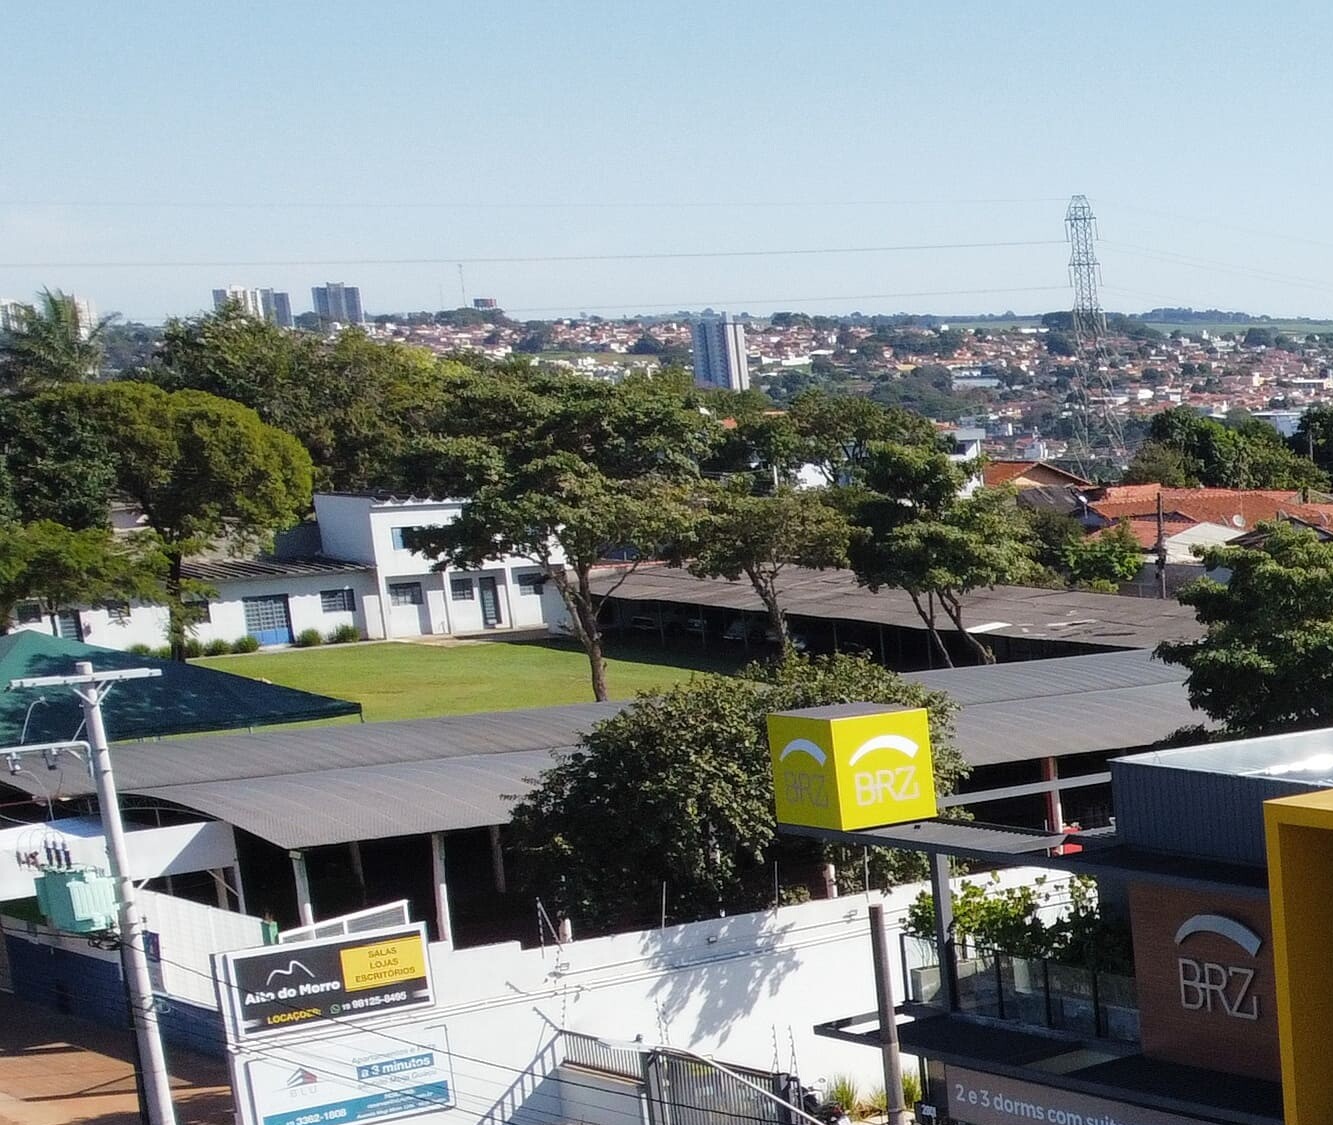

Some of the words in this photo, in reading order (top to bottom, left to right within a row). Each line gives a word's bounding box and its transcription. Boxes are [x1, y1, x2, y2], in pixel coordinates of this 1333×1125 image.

[784, 771, 829, 809] BRZ
[854, 765, 921, 807] BRZ
[368, 947, 397, 958] SALAS
[369, 957, 399, 969] LOJAS
[277, 982, 297, 1000] do
[299, 980, 341, 996] Morro
[1178, 957, 1258, 1020] BRZ
[382, 1056, 431, 1074] minutos
[955, 1083, 966, 1102] 2
[968, 1090, 977, 1105] e
[980, 1089, 990, 1108] 3
[993, 1093, 1045, 1121] dorms
